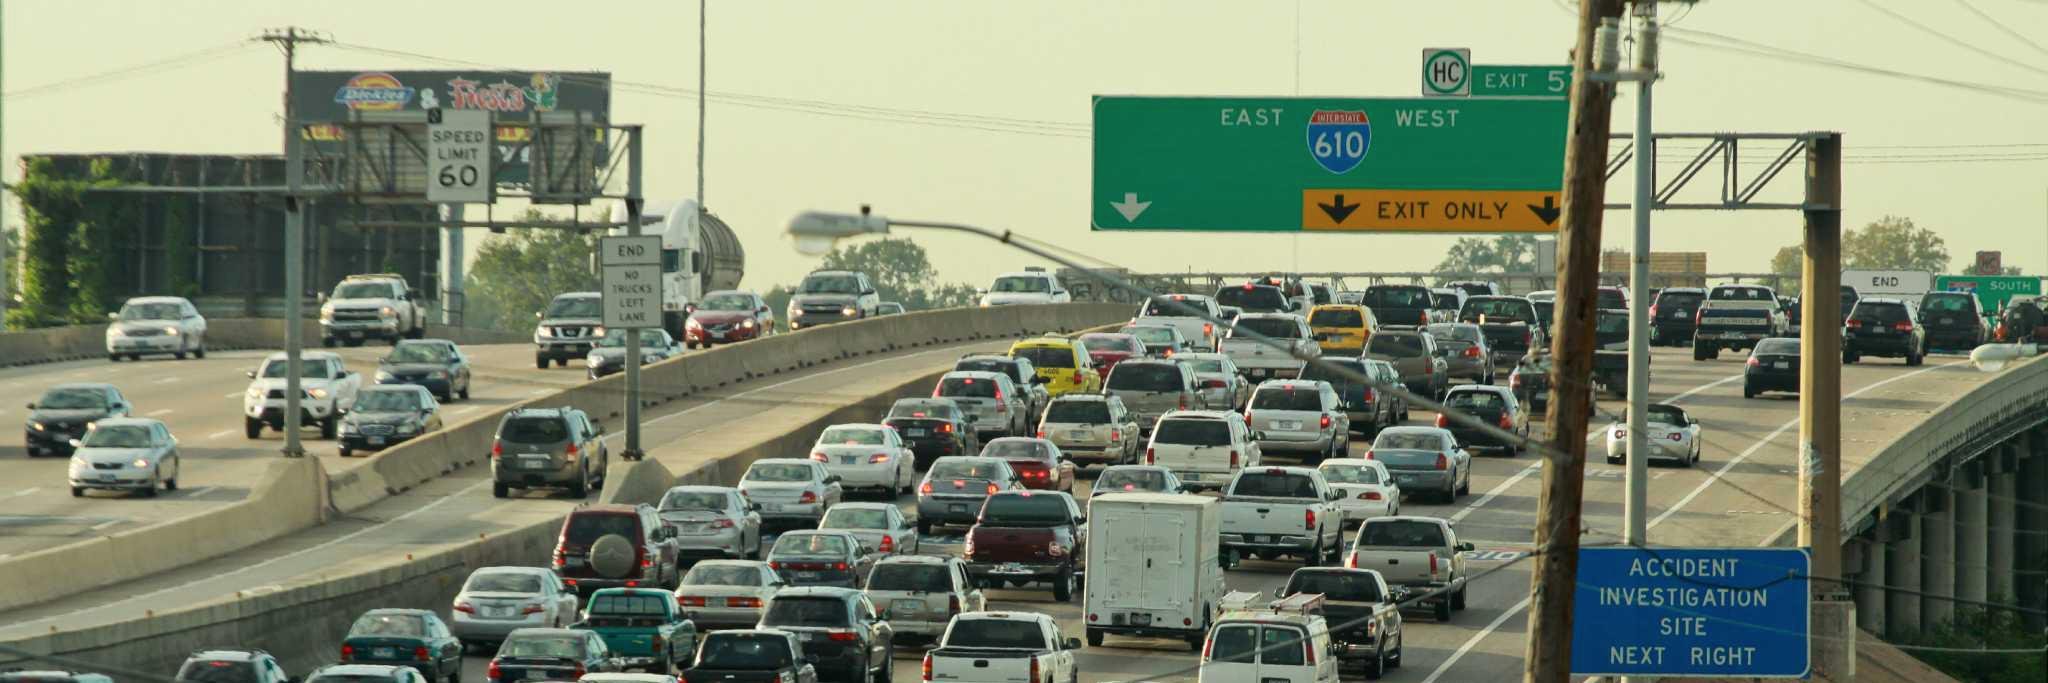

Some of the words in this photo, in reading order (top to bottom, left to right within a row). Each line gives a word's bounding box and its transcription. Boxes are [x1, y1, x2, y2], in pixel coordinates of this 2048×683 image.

[1433, 62, 1460, 83] HC
[1485, 73, 1529, 88] EXIT
[1548, 70, 1573, 92] 5
[448, 77, 525, 112] Fiesta
[1221, 108, 1284, 126] EAST
[1395, 109, 1460, 127] WEST
[1317, 113, 1361, 121] INTERSTATE
[432, 130, 484, 144] SPEED
[1315, 131, 1364, 158] 610
[438, 148, 478, 161] LIMIT
[439, 165, 478, 187] 60
[1377, 201, 1430, 219] EXIT
[1444, 202, 1509, 220] ONLY
[618, 245, 645, 257] END
[624, 271, 639, 280] NO
[1872, 277, 1899, 287] END
[612, 284, 652, 293] TRUCKS
[1990, 281, 2032, 291] SOUTH
[620, 298, 645, 308] LEFT
[619, 312, 646, 321] LANE
[1629, 558, 1739, 577] ACCIDENT
[1599, 587, 1768, 607] INVESTIGATION
[1660, 617, 1707, 636] SITE
[1610, 646, 1666, 665] NEXT
[1691, 647, 1756, 666] RIGHT
